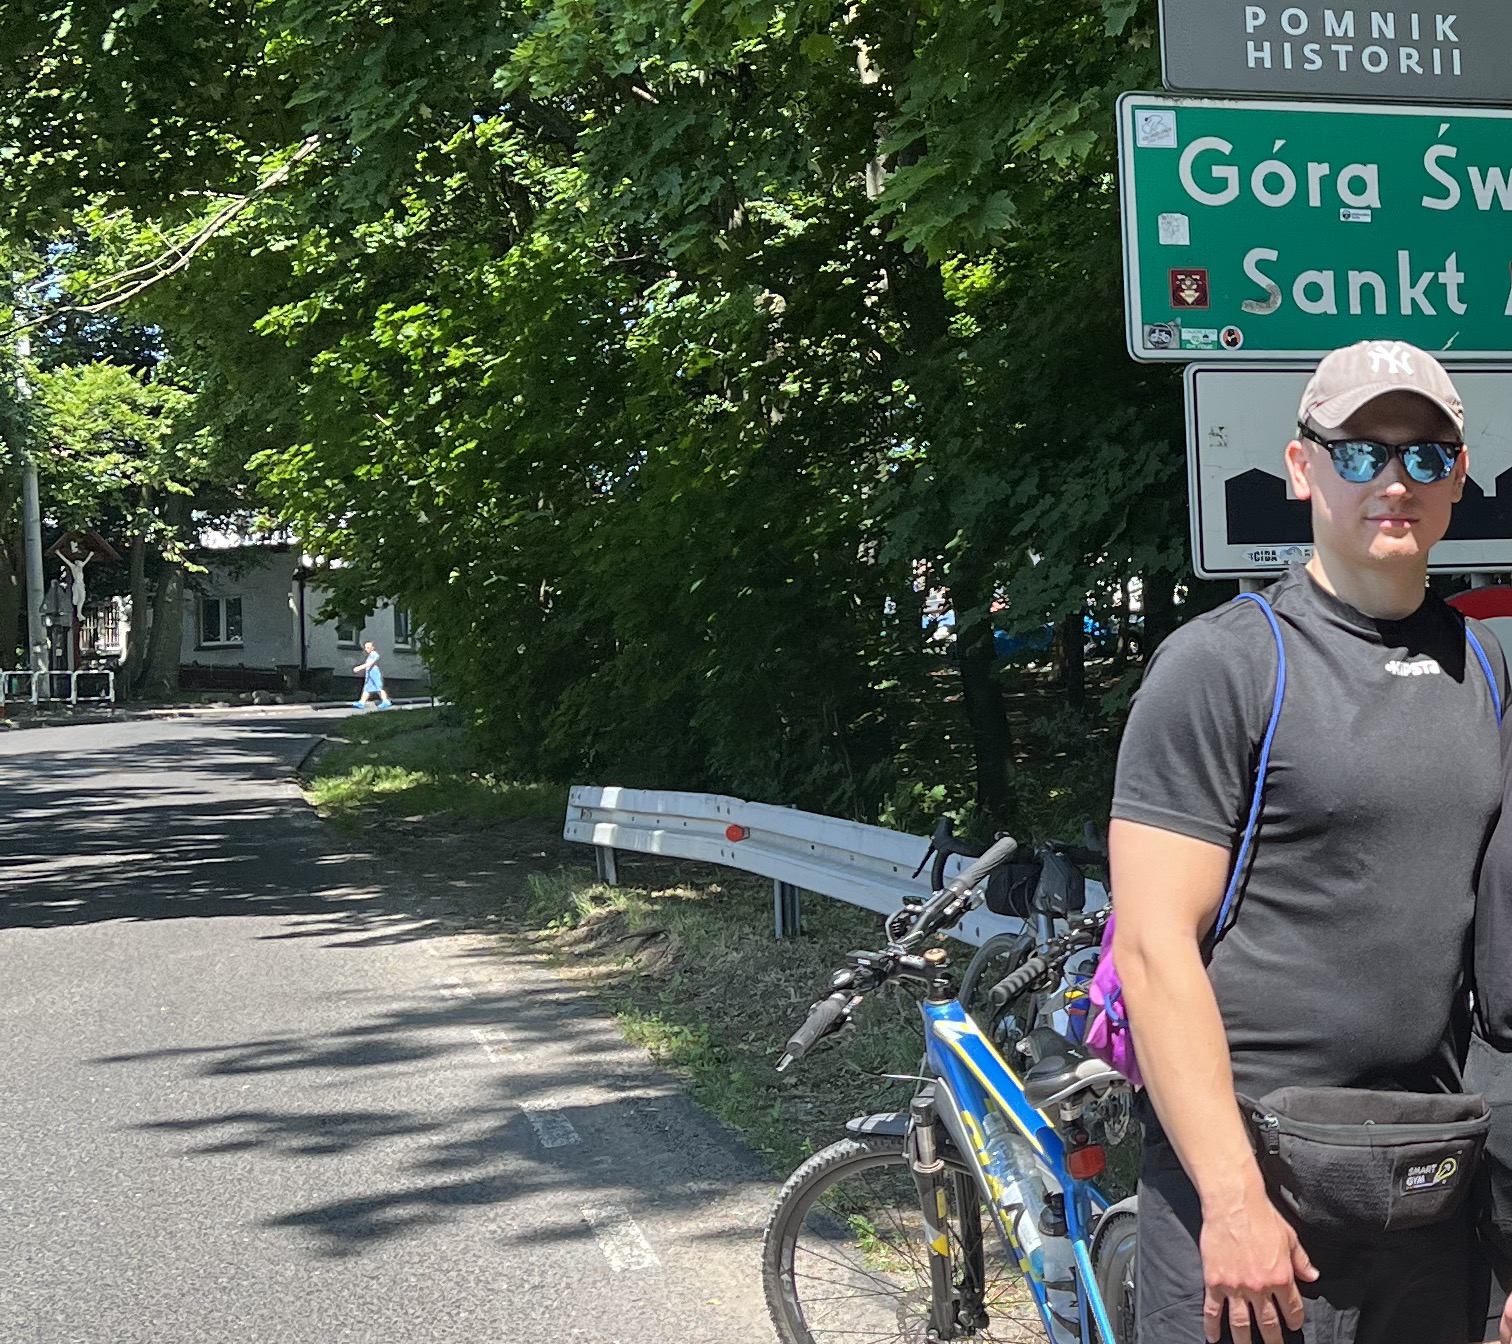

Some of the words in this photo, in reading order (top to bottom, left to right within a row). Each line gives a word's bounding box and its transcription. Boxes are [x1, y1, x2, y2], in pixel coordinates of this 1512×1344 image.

[1244, 5, 1460, 43] POMNIK
[1246, 39, 1462, 76] HISTORII
[1178, 136, 1382, 209] Góra
[1240, 247, 1468, 316] Sankt
[1367, 344, 1415, 377] NY
[1407, 1163, 1438, 1177] SMART
